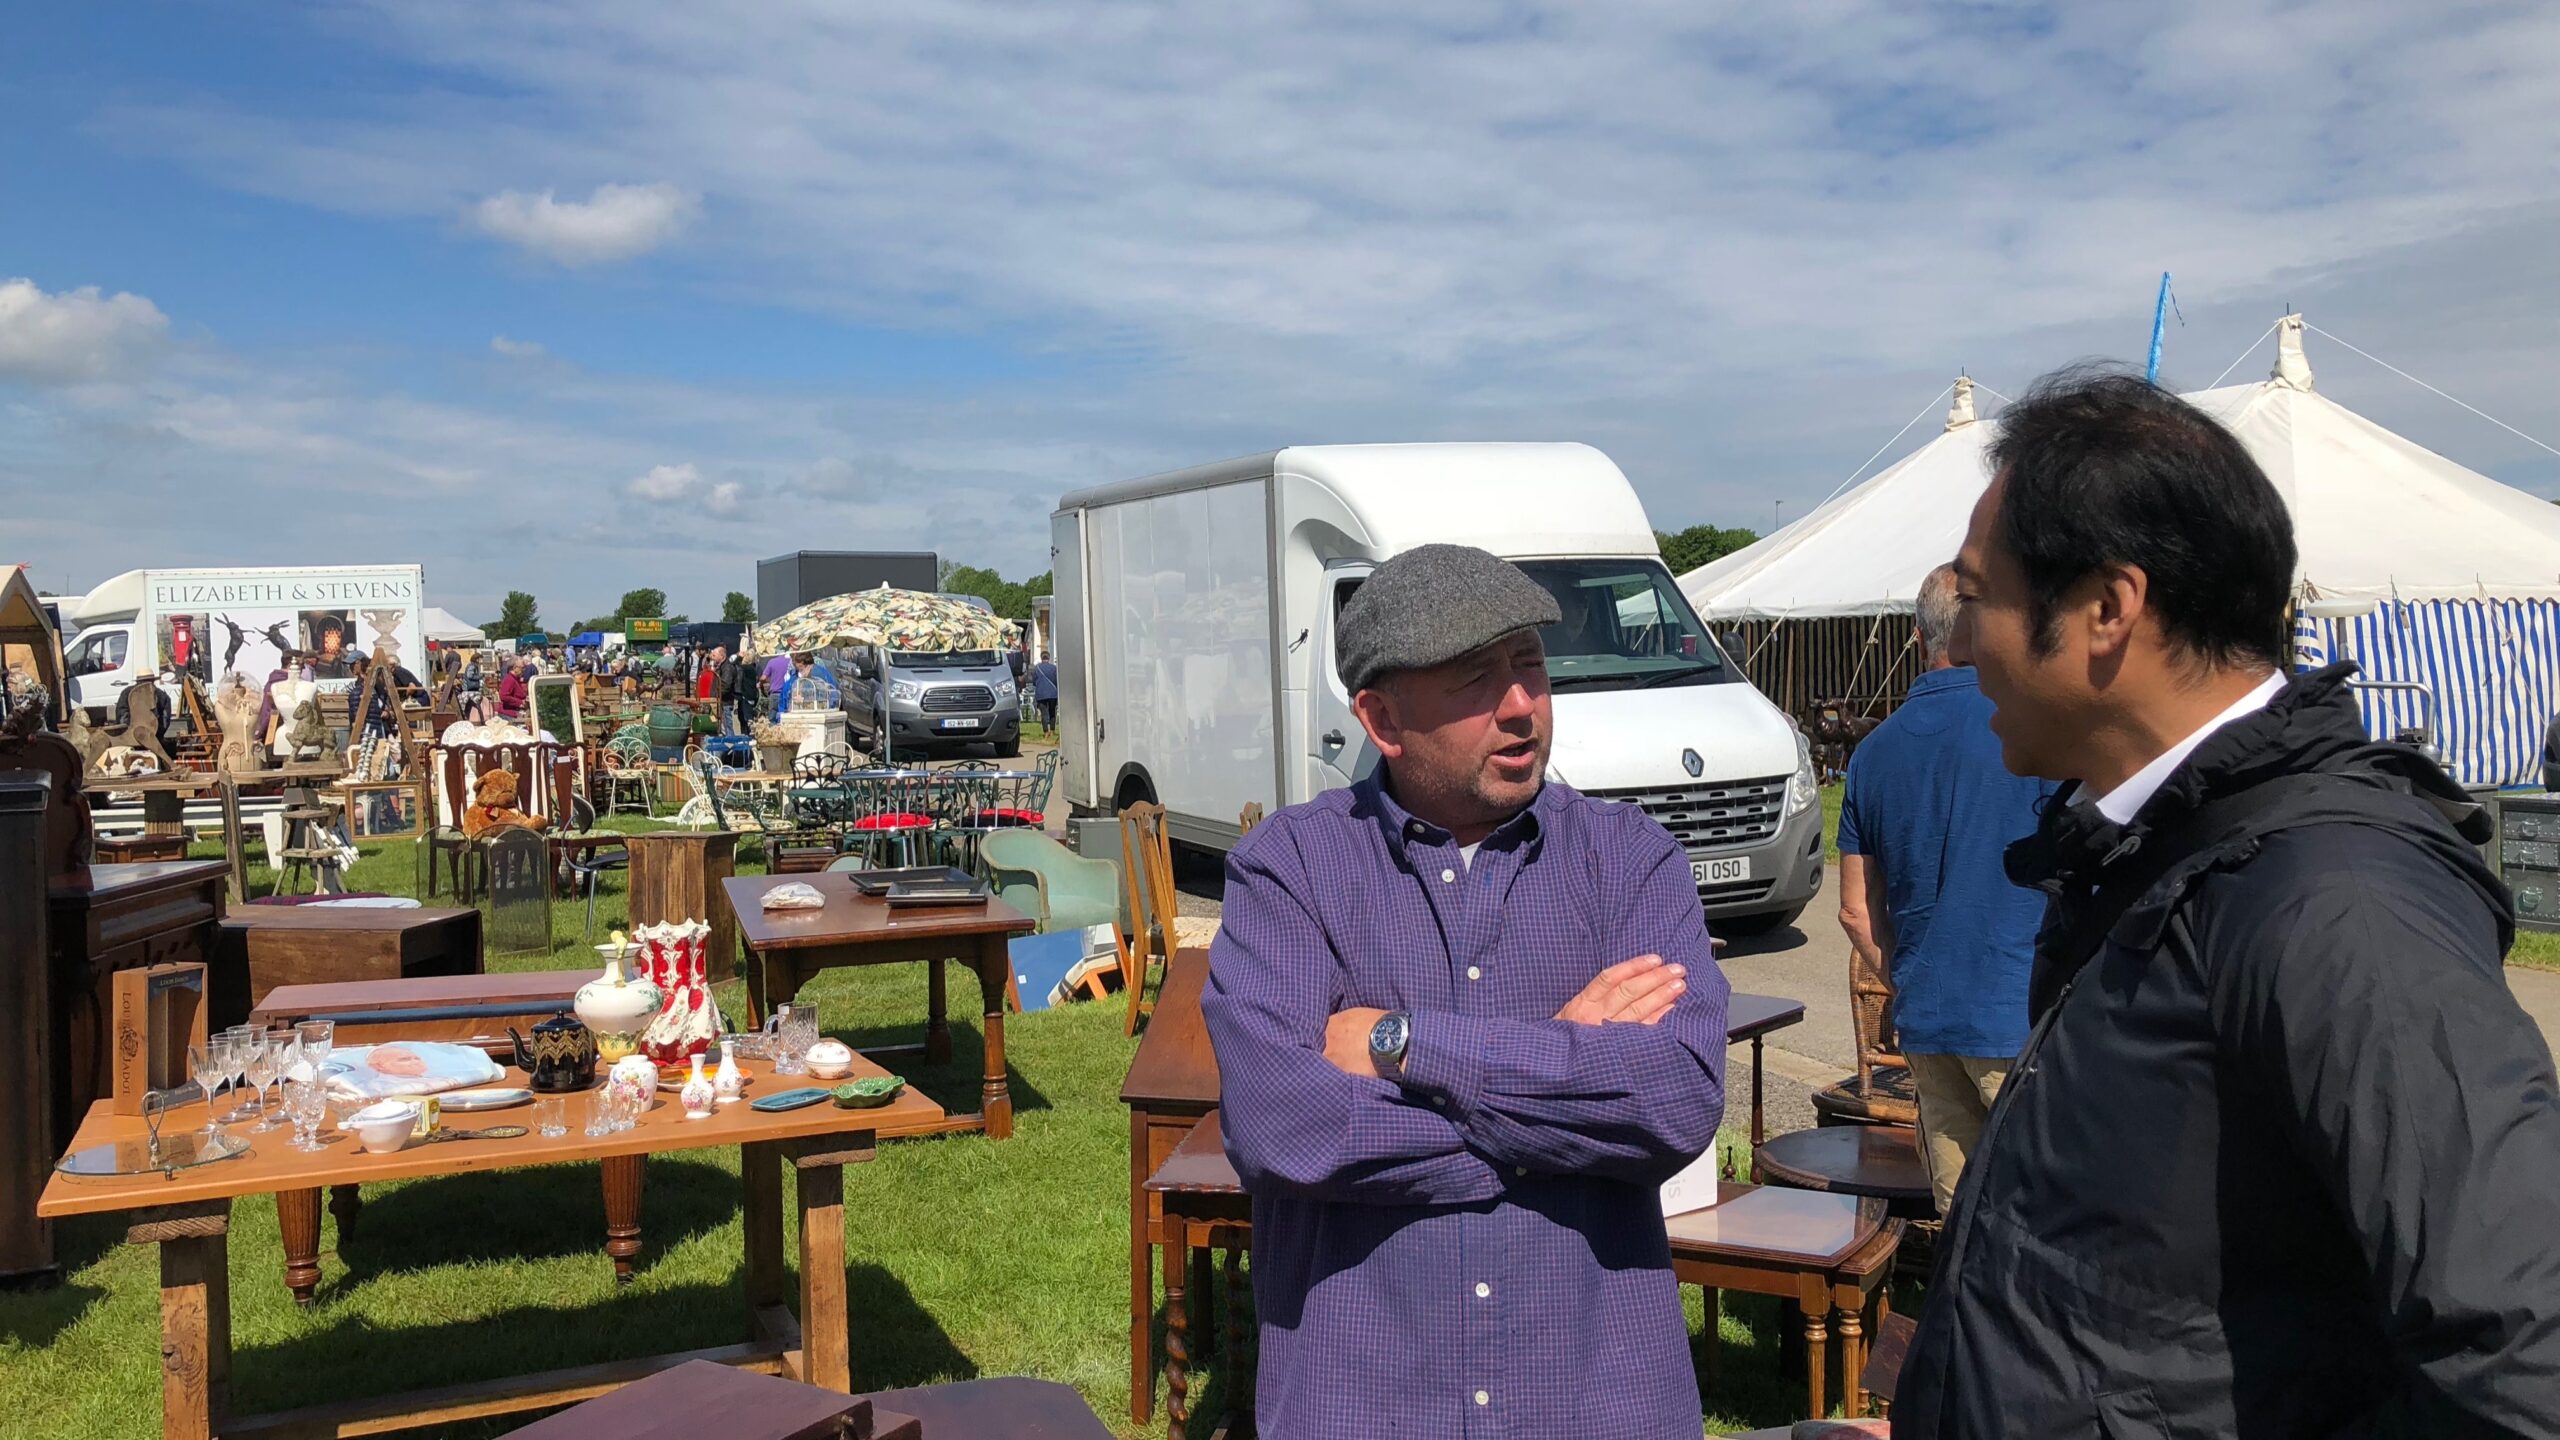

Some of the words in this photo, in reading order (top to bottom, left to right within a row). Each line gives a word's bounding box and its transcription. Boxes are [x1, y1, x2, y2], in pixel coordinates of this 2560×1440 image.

[156, 584, 282, 603] ELIZABETH
[292, 583, 307, 600] &
[316, 581, 412, 599] STEVENS
[1693, 864, 1707, 881] 61
[1712, 860, 1740, 879] OSO
[122, 1057, 132, 1096] JADOT
